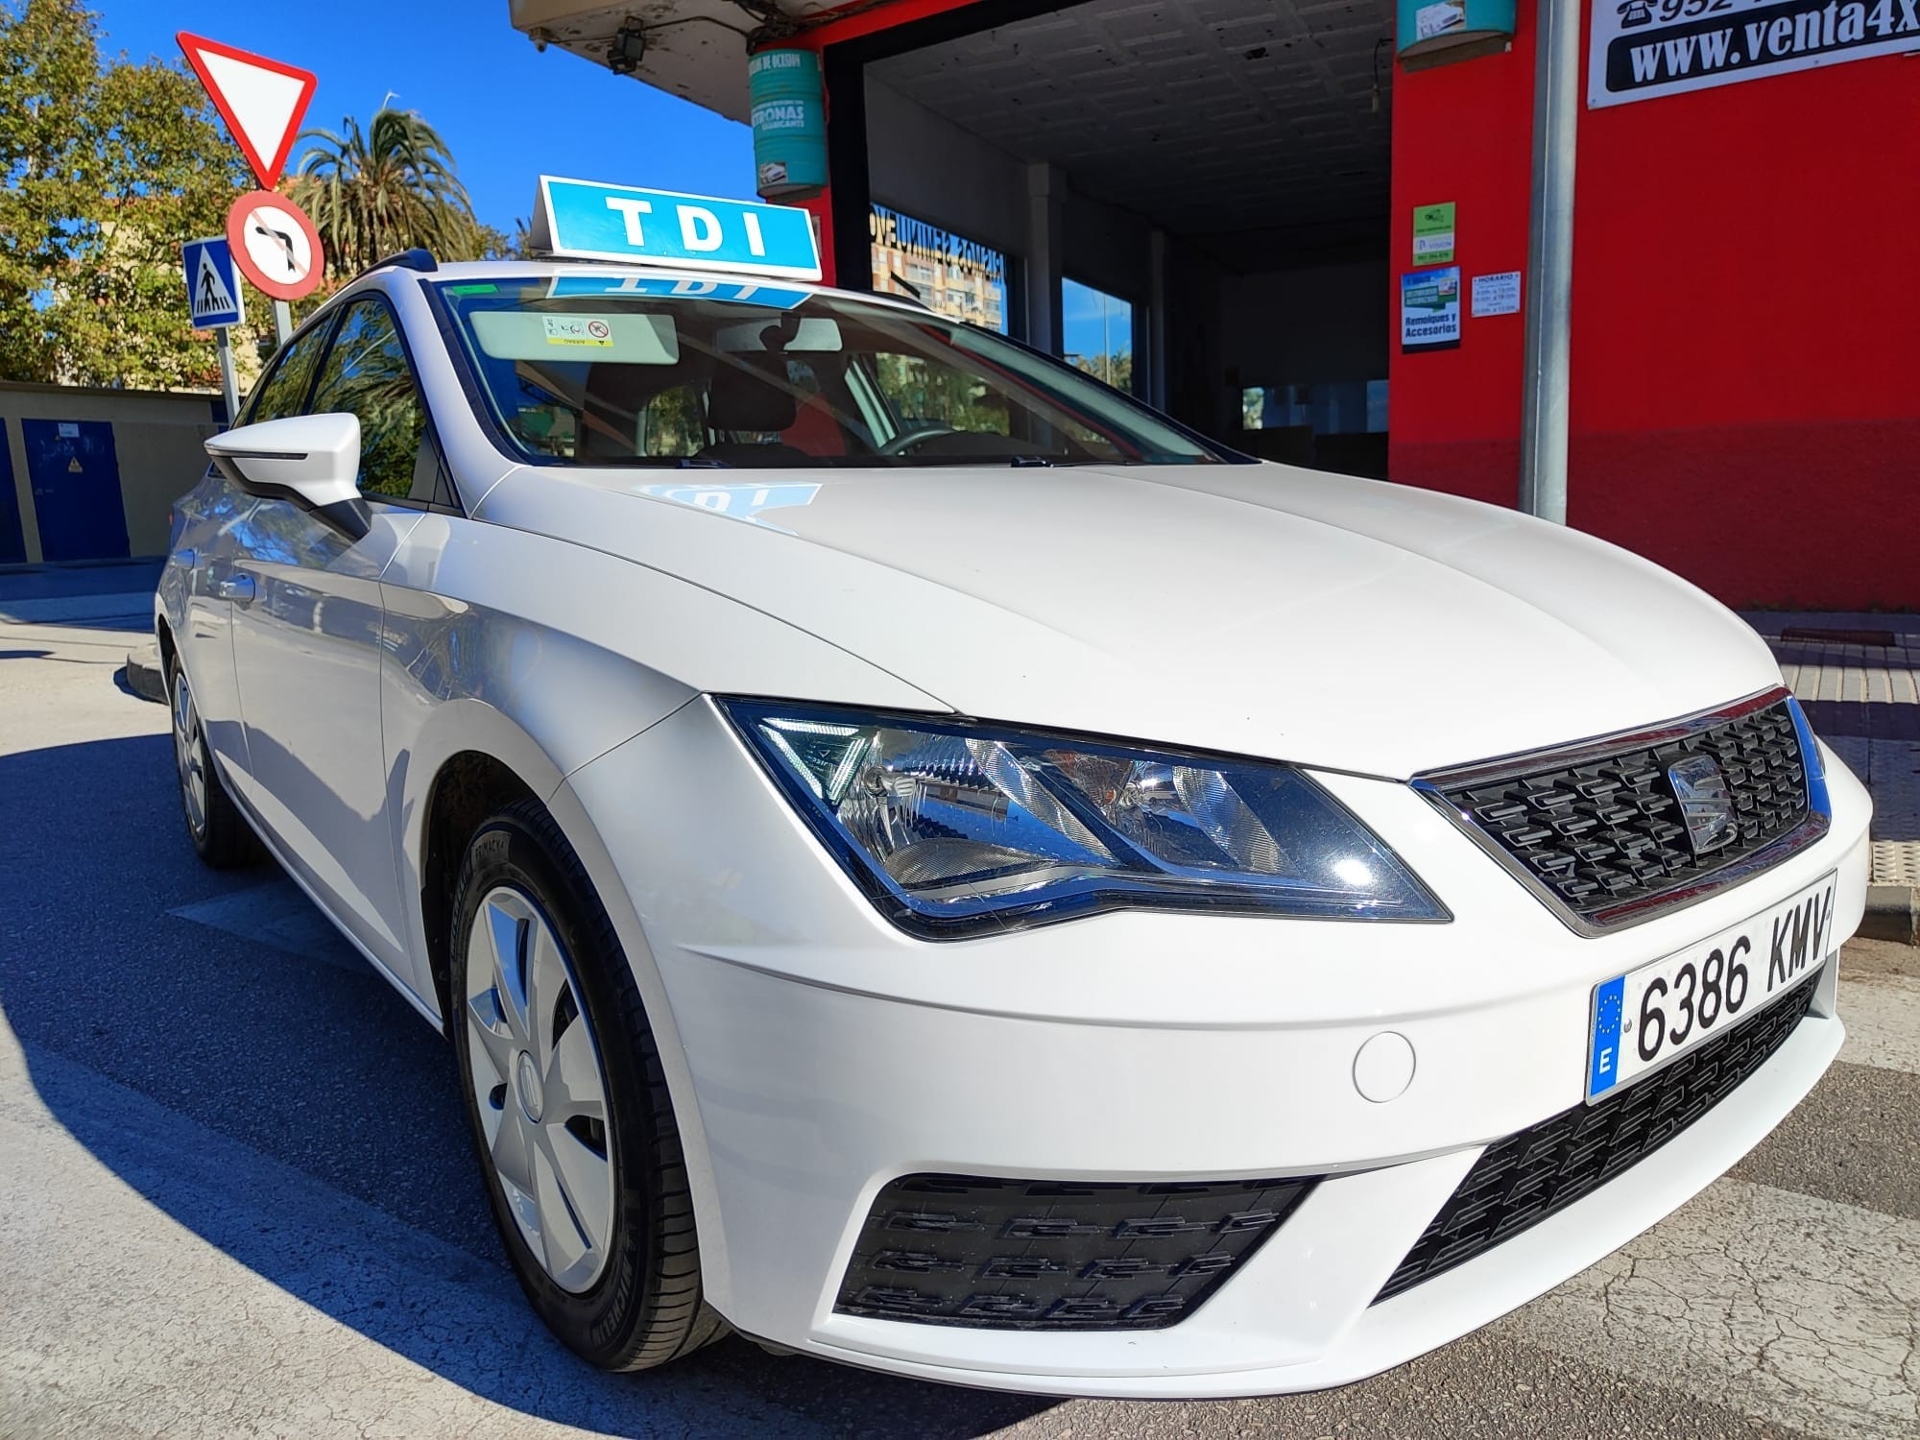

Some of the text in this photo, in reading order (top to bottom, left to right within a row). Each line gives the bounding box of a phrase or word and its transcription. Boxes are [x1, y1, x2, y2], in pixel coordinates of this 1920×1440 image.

[1630, 0, 1920, 83] www.venta4x
[605, 196, 766, 257] TDI
[1478, 273, 1513, 283] HORARIO
[1405, 323, 1457, 338] Accesorios
[1638, 886, 1832, 1062] 6386 KMV
[1599, 1047, 1612, 1074] E
